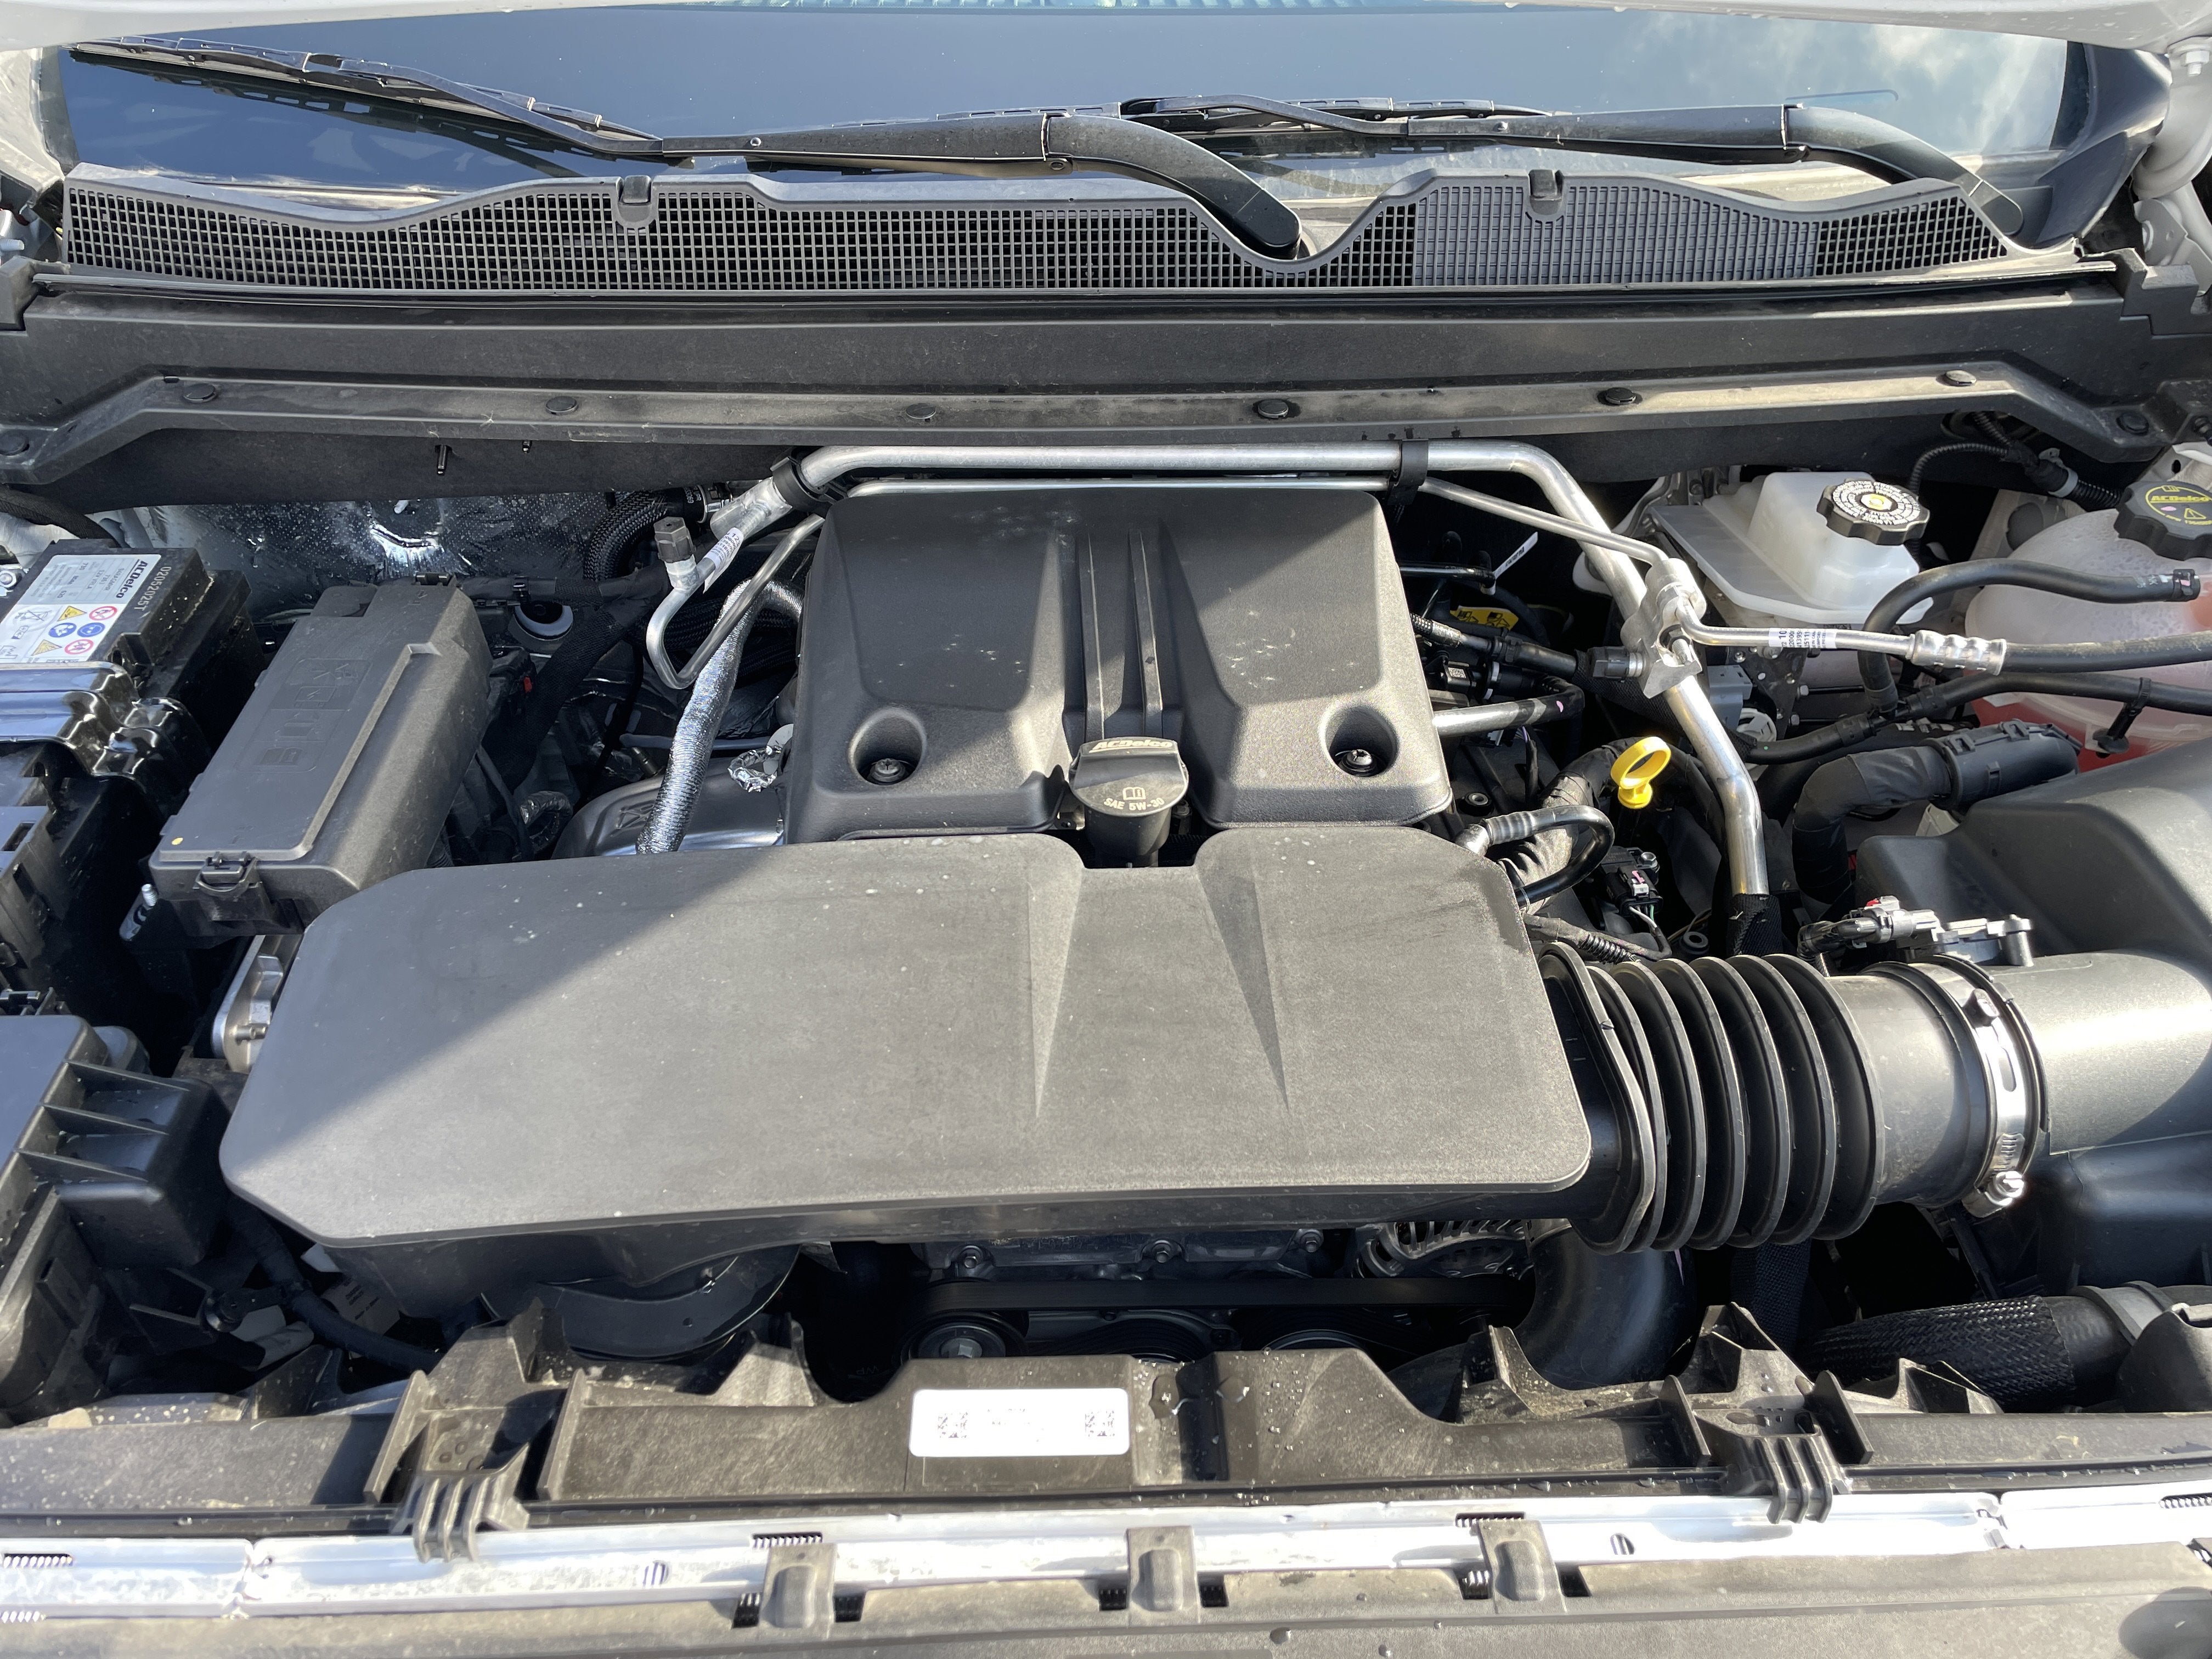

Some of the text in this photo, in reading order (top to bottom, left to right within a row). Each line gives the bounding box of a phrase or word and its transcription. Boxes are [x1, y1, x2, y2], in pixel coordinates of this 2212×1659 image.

[116, 560, 148, 599] ACDelco
[134, 566, 172, 611] 02052025T
[1092, 739, 1173, 751] ACDelco
[1104, 797, 1165, 811] SAE 5W-30
